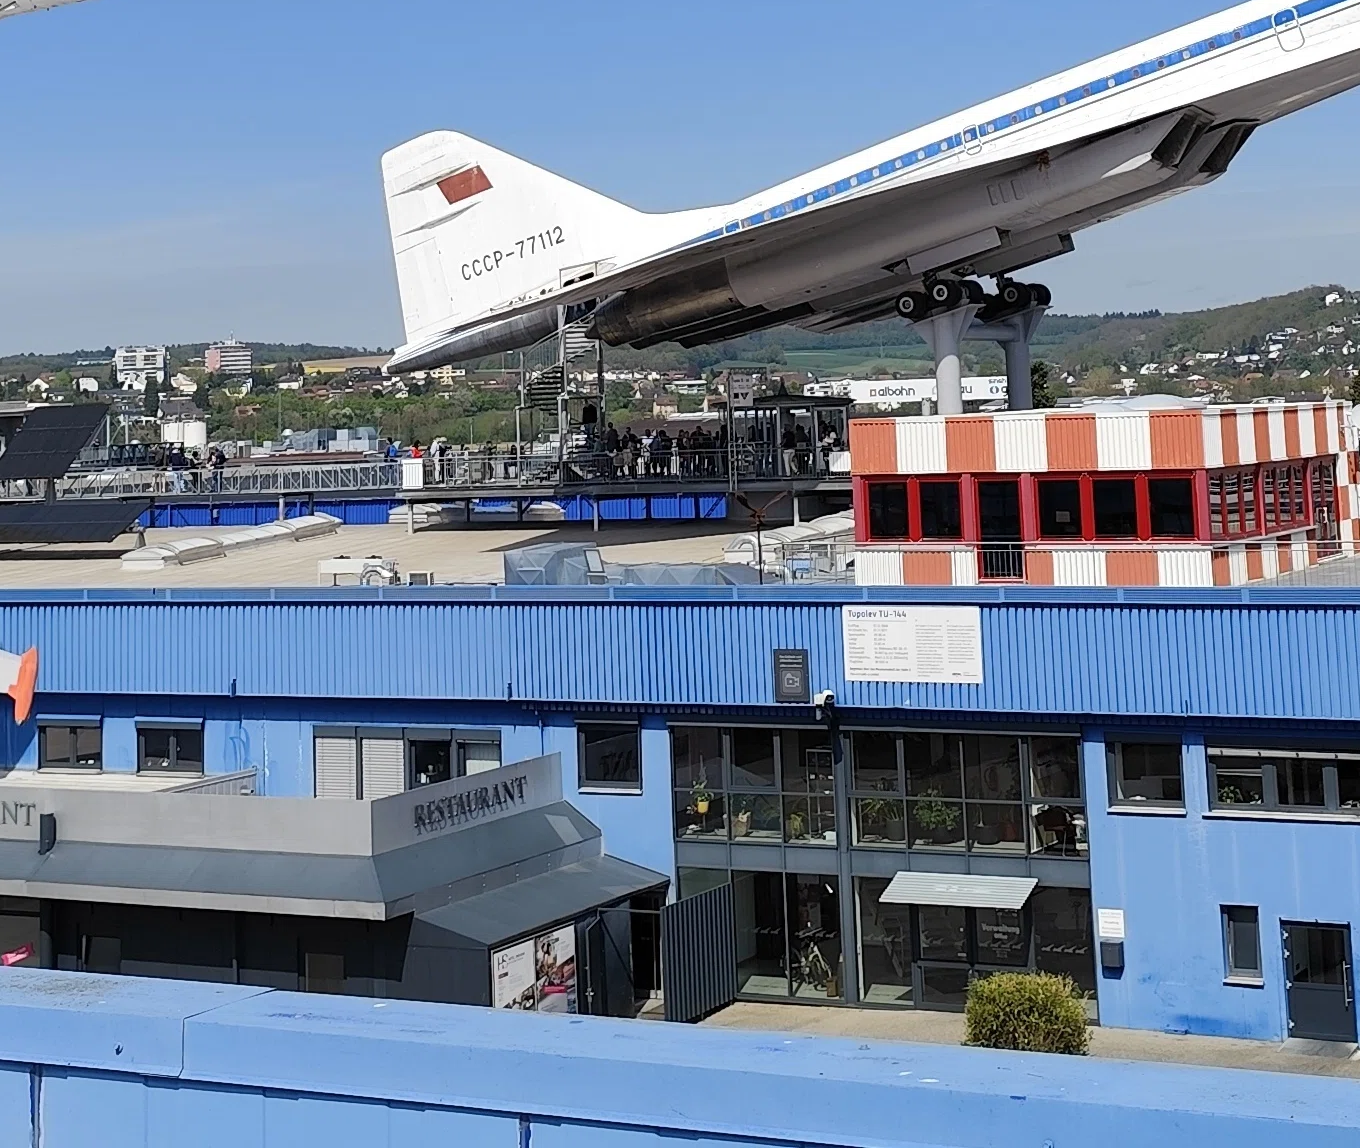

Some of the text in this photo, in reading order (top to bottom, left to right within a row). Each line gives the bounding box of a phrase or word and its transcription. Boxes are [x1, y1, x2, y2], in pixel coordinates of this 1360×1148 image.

[847, 609, 907, 619] Tupolev TU-144
[414, 775, 528, 829] RESTAURANT
